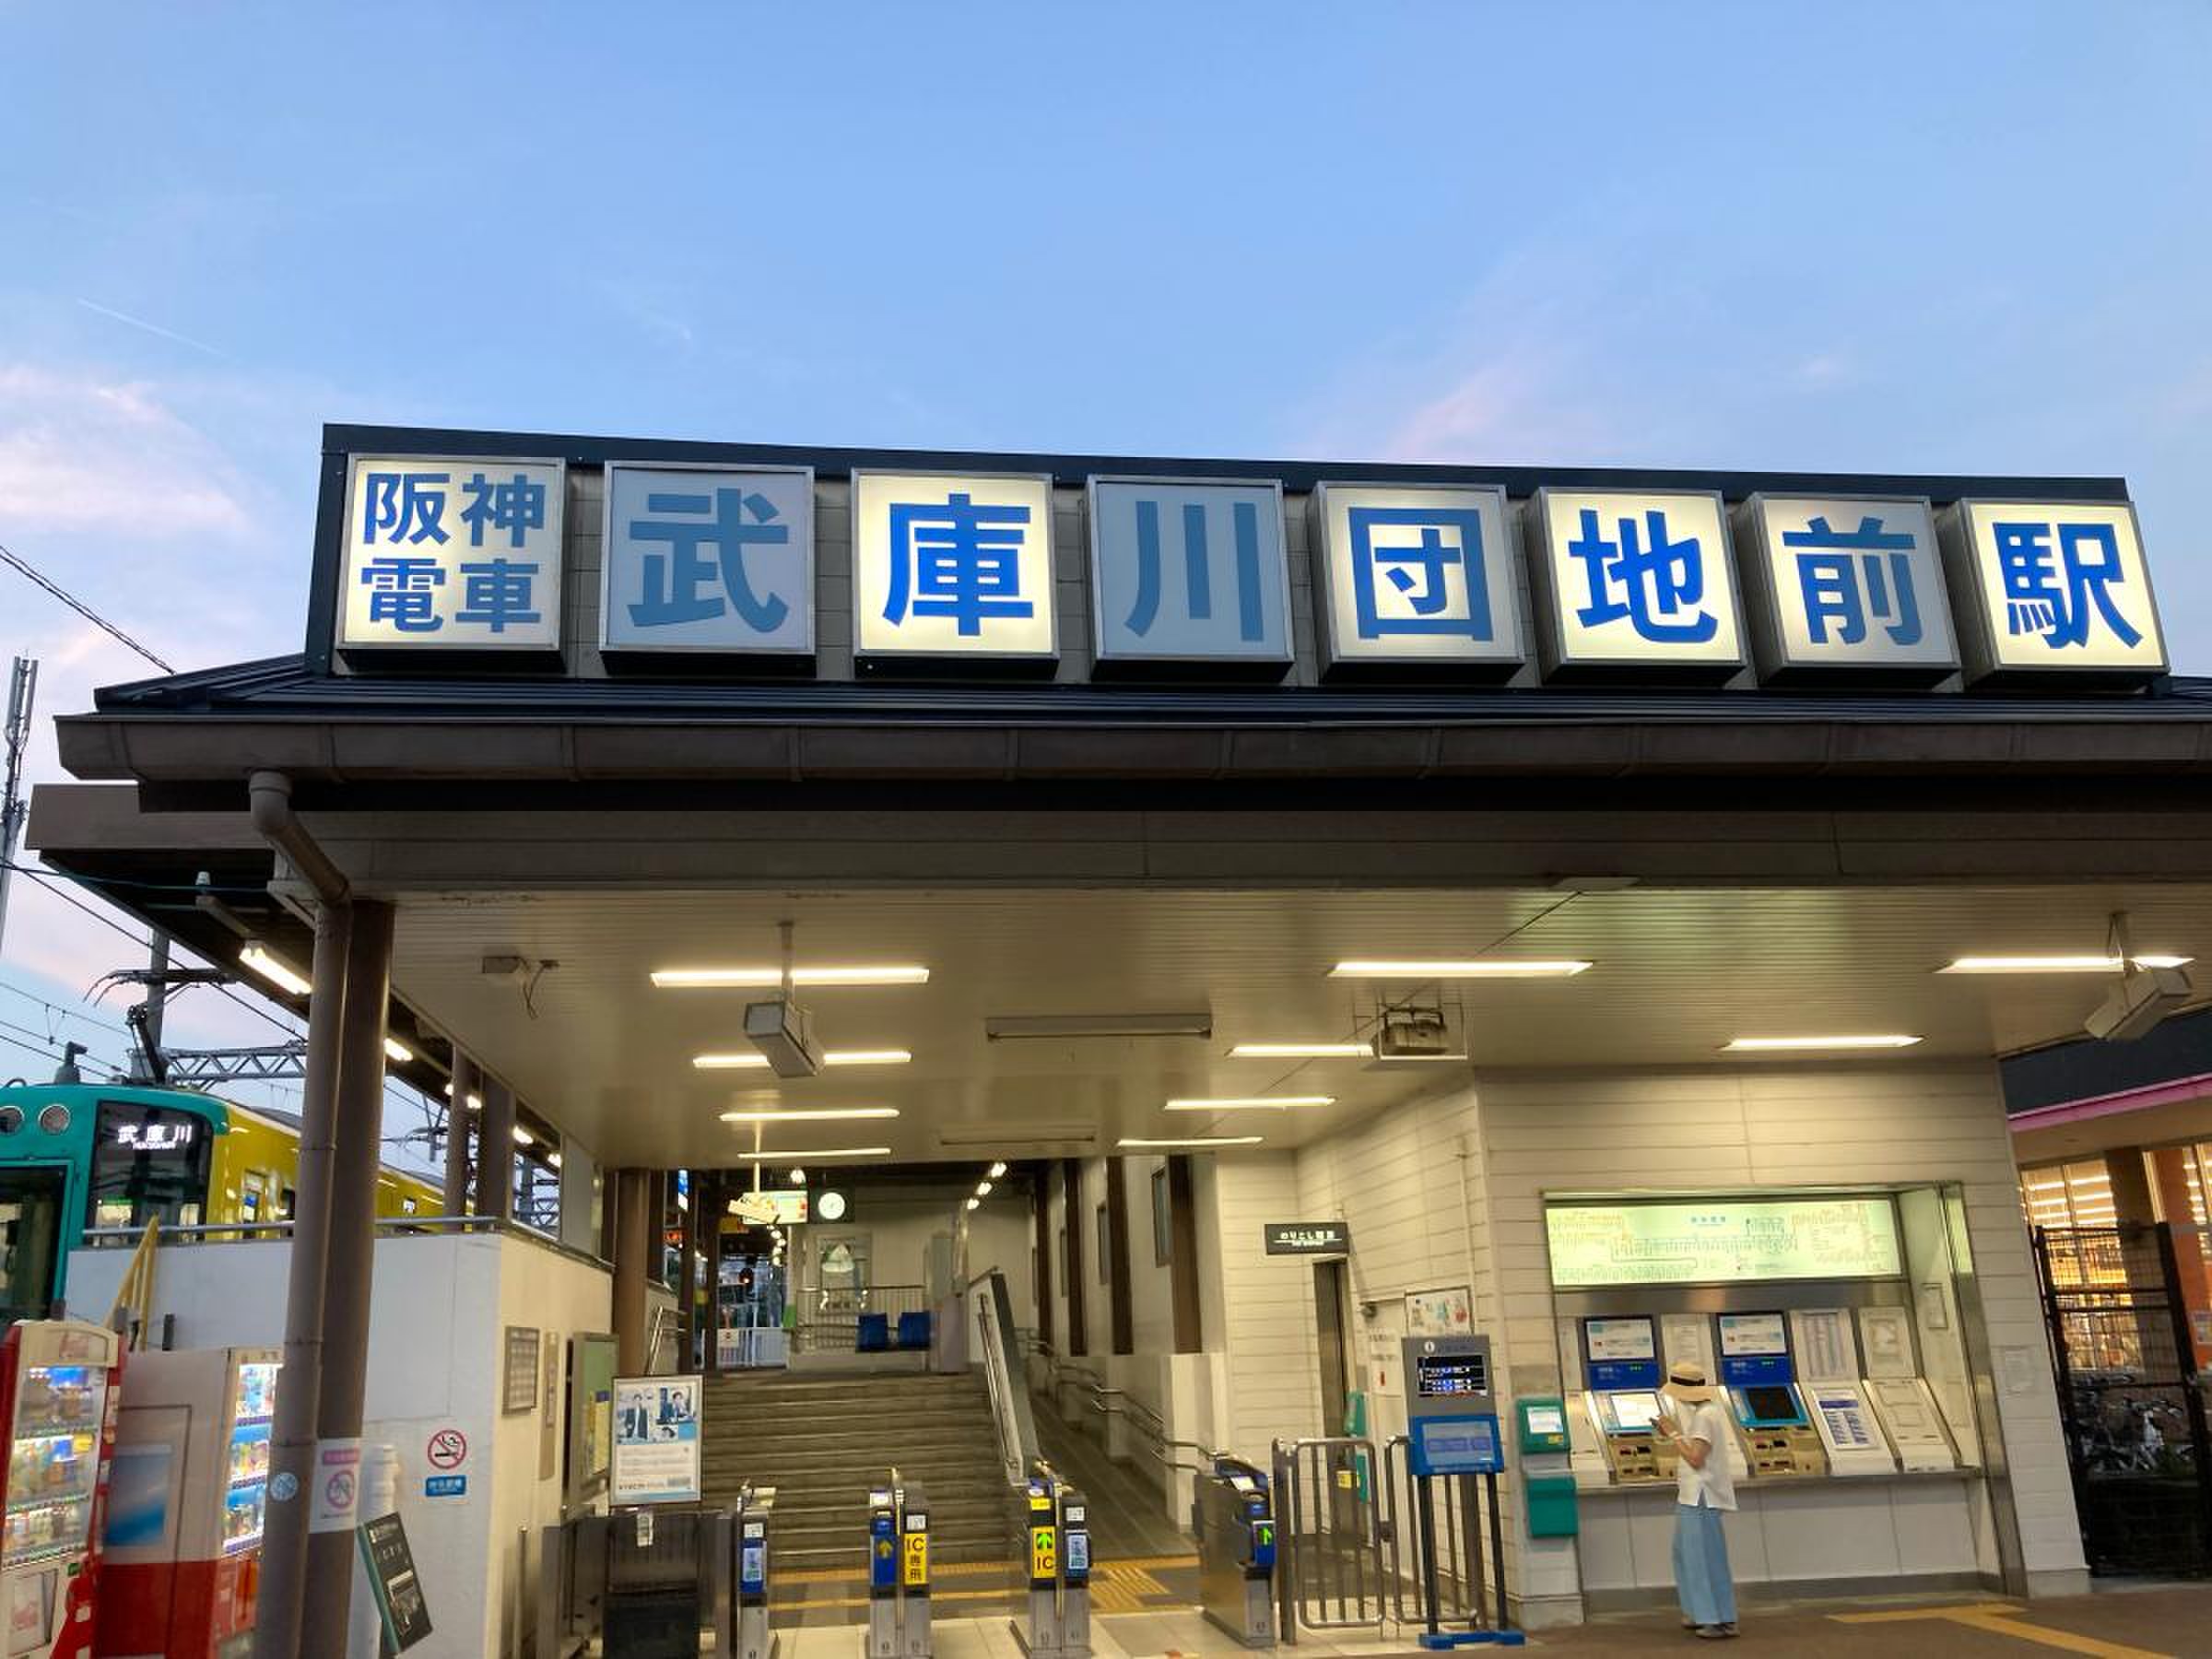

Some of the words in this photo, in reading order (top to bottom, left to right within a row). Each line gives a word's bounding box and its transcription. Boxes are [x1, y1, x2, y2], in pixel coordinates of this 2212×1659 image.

[363, 473, 546, 547] 阪神
[627, 487, 2143, 649] 武庫川団地前駅
[361, 559, 542, 633] 電車
[117, 1124, 192, 1144] 武庫川
[906, 1538, 924, 1553] IC
[1036, 1556, 1054, 1571] IC
